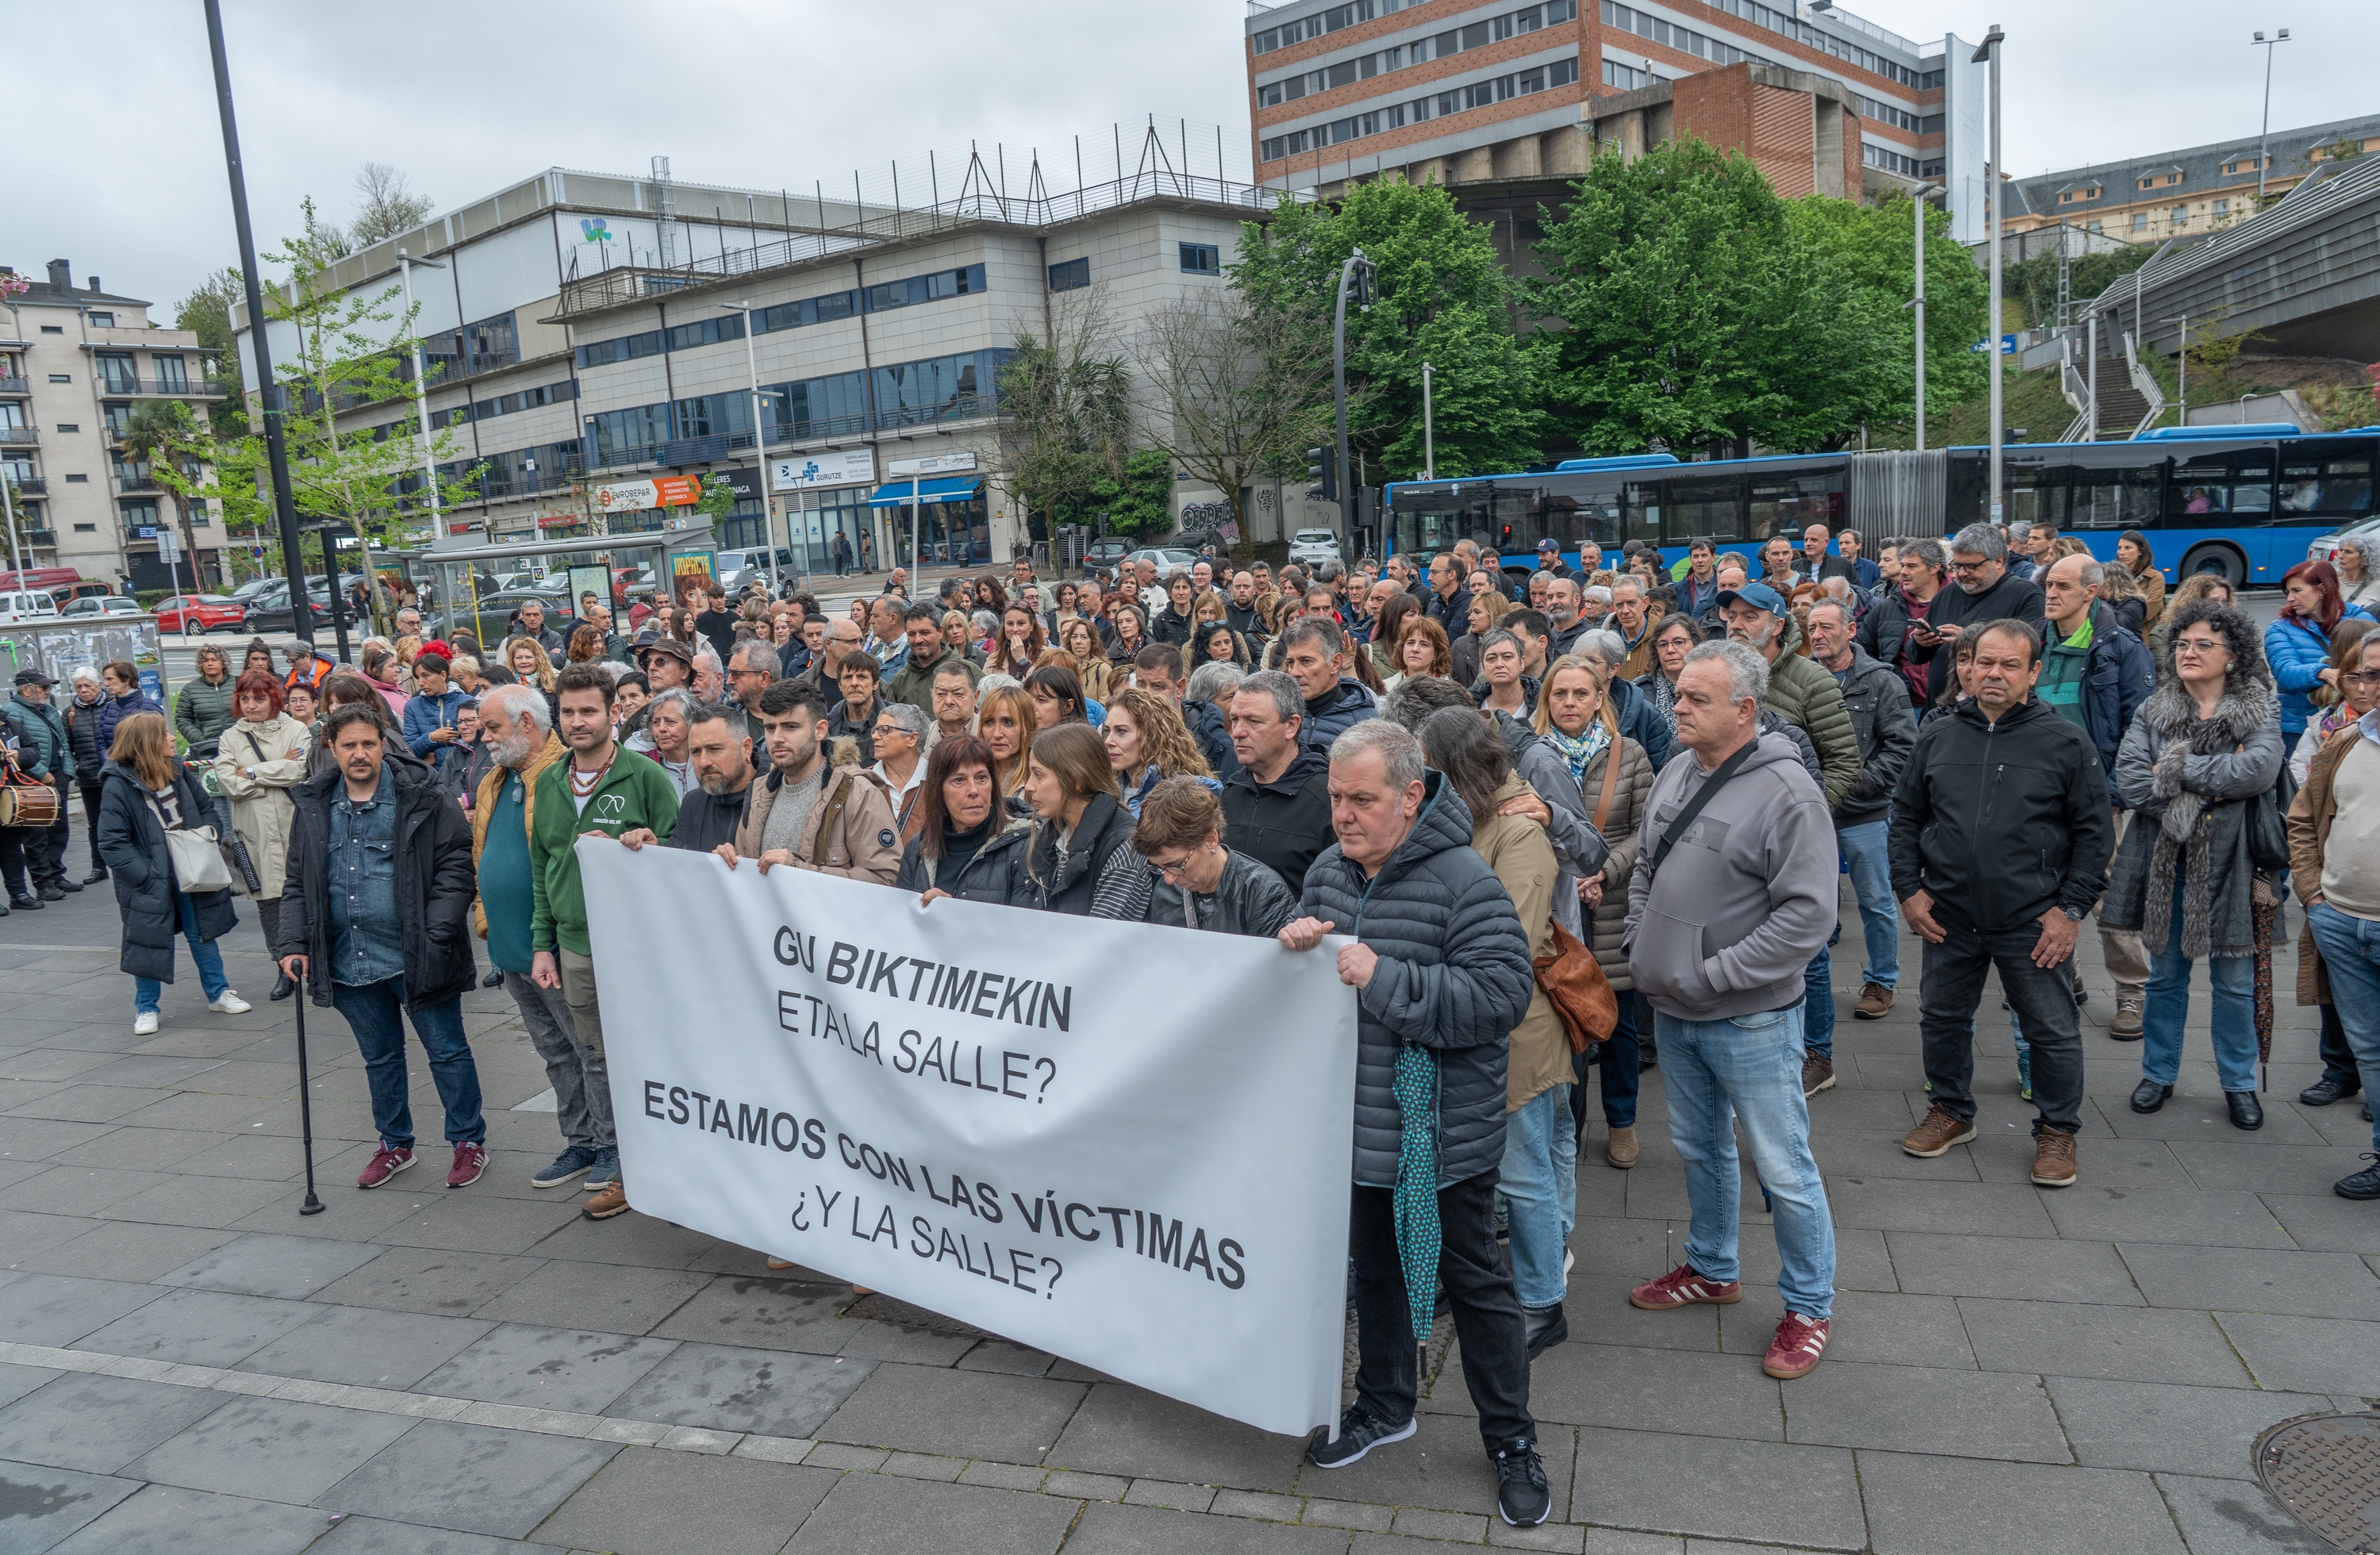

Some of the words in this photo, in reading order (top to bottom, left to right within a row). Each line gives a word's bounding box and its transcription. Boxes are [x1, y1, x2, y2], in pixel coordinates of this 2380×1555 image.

[611, 488, 651, 499] EUROREPAR
[816, 472, 842, 481] GURUTZE
[674, 555, 711, 576] IMPACTA
[774, 925, 816, 973] GU
[827, 941, 1072, 1032] BIKTIMEKIN
[778, 989, 845, 1046] ETA
[843, 1012, 884, 1066] LA
[893, 1029, 1056, 1104] SALLE?
[644, 1079, 826, 1160] ESTAMOS
[838, 1132, 916, 1193] CON
[920, 1165, 1004, 1224] LAS
[1011, 1188, 1246, 1290] VÍCTIMAS
[791, 1184, 842, 1232] ¿Y
[852, 1196, 899, 1250] LA
[911, 1215, 1065, 1300] SALLE?
